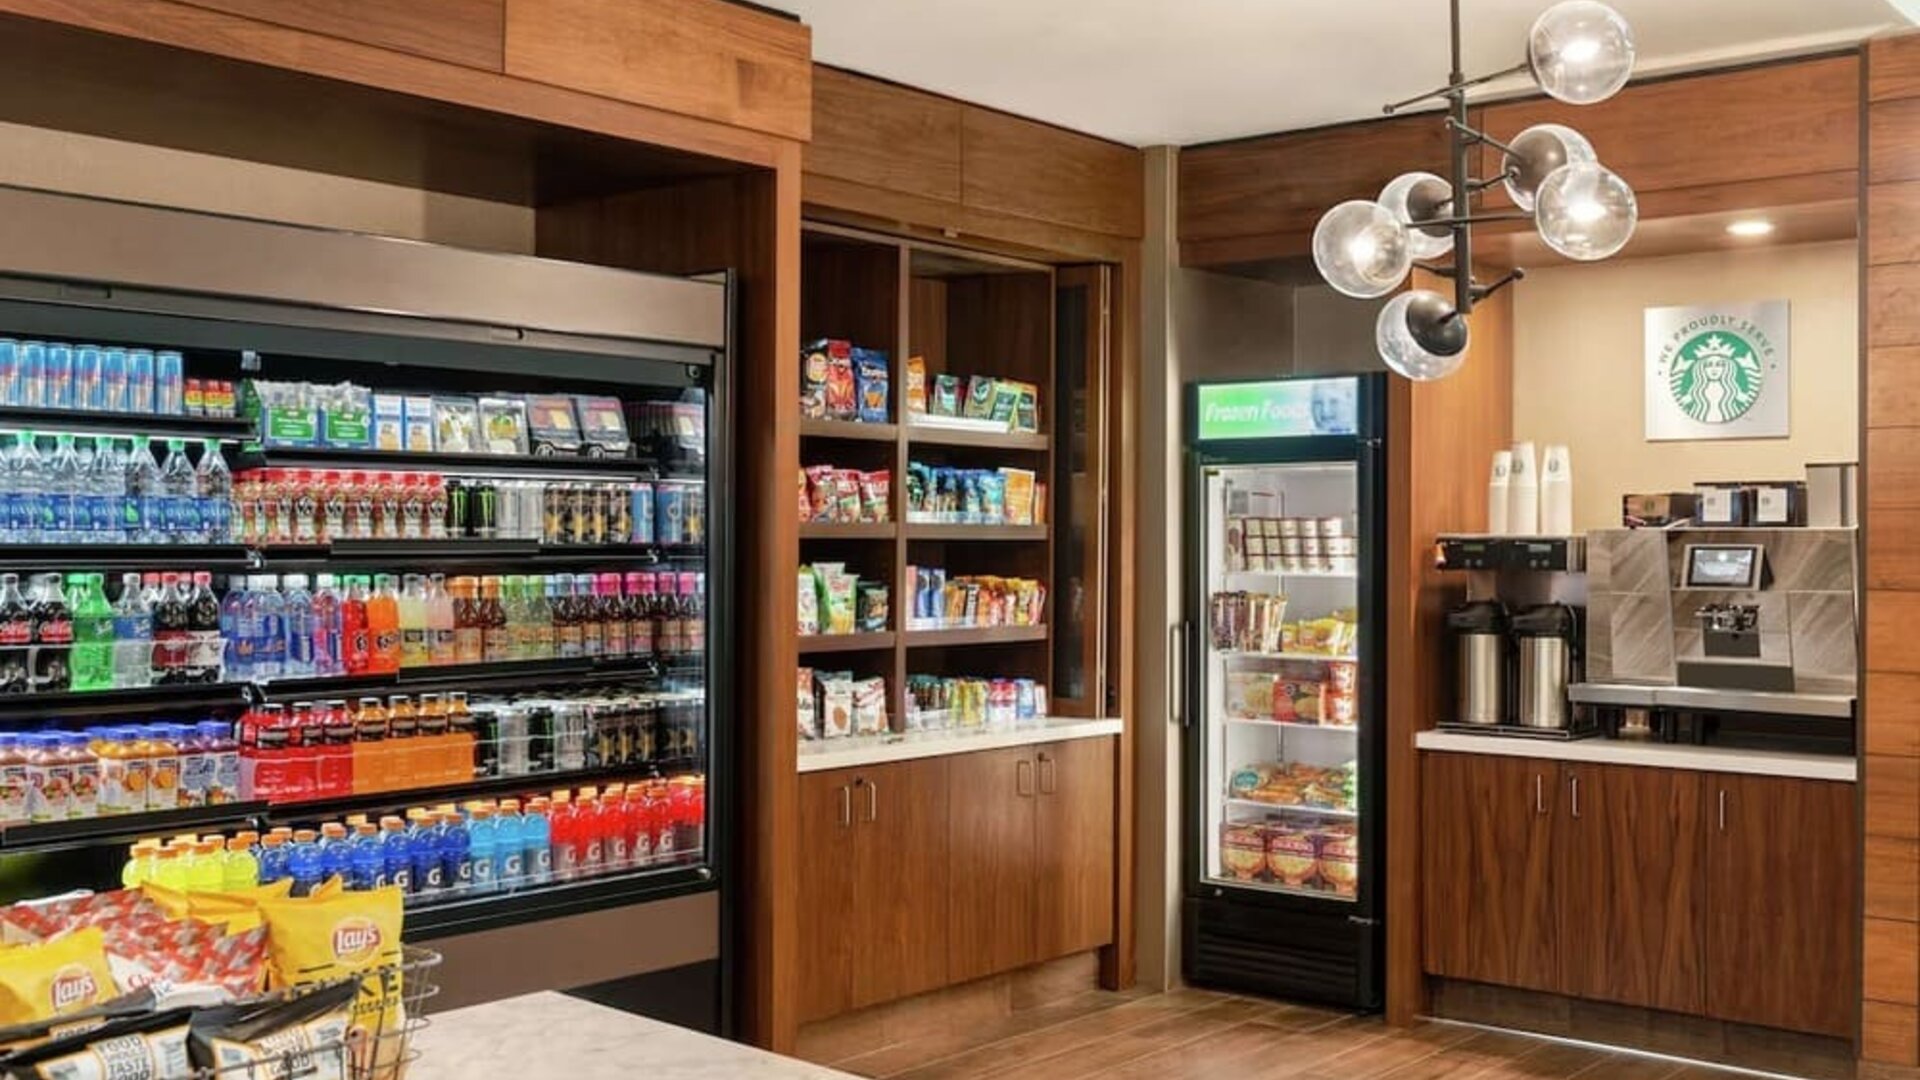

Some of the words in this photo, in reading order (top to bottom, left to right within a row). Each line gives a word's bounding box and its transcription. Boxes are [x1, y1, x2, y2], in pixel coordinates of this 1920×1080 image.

[1674, 314, 1736, 341] PROUDLY
[1740, 320, 1775, 357] SERVE
[1205, 401, 1260, 423] Frozen
[538, 848, 551, 867] G
[587, 842, 600, 860] G
[460, 862, 472, 879] G
[474, 858, 490, 877] G
[505, 854, 521, 874] G
[394, 869, 409, 888] G
[428, 866, 442, 885] G
